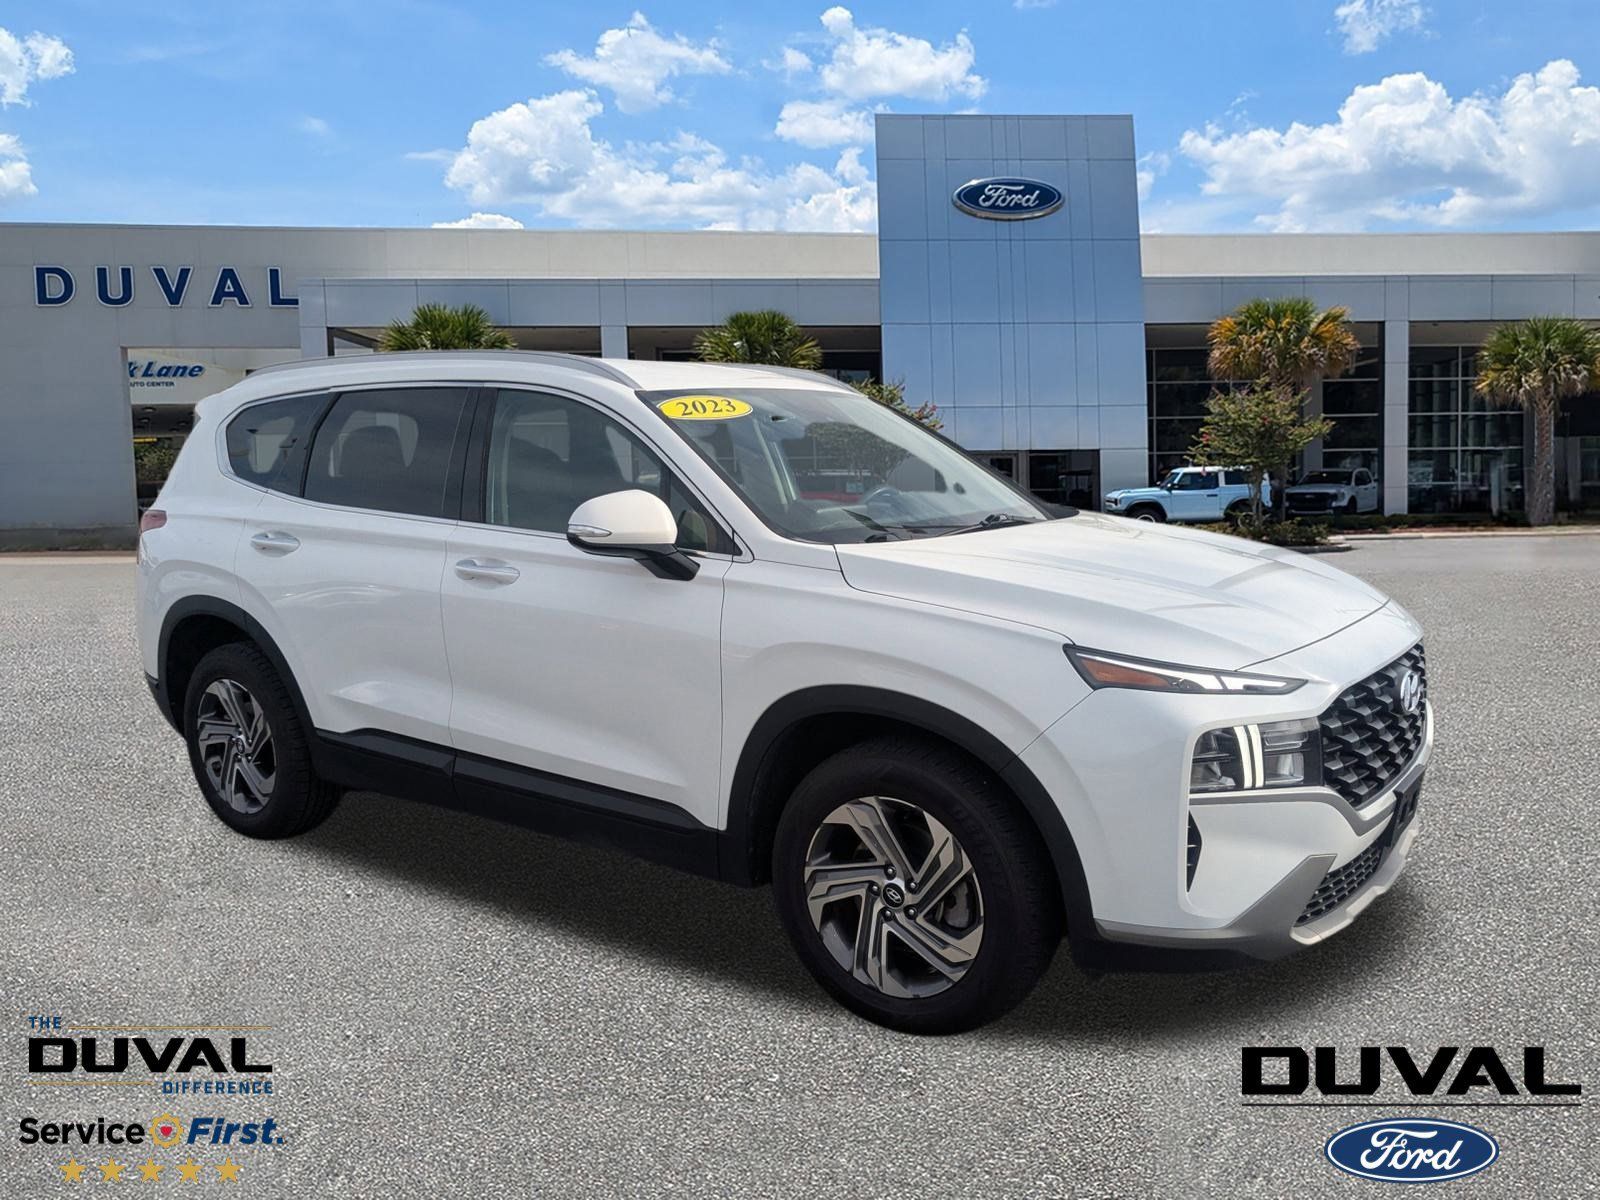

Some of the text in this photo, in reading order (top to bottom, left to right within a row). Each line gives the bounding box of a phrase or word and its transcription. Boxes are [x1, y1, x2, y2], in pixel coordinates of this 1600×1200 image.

[979, 184, 1041, 207] Ford
[33, 265, 299, 307] DUVAL
[141, 361, 205, 378] Lane
[676, 398, 736, 416] 2023
